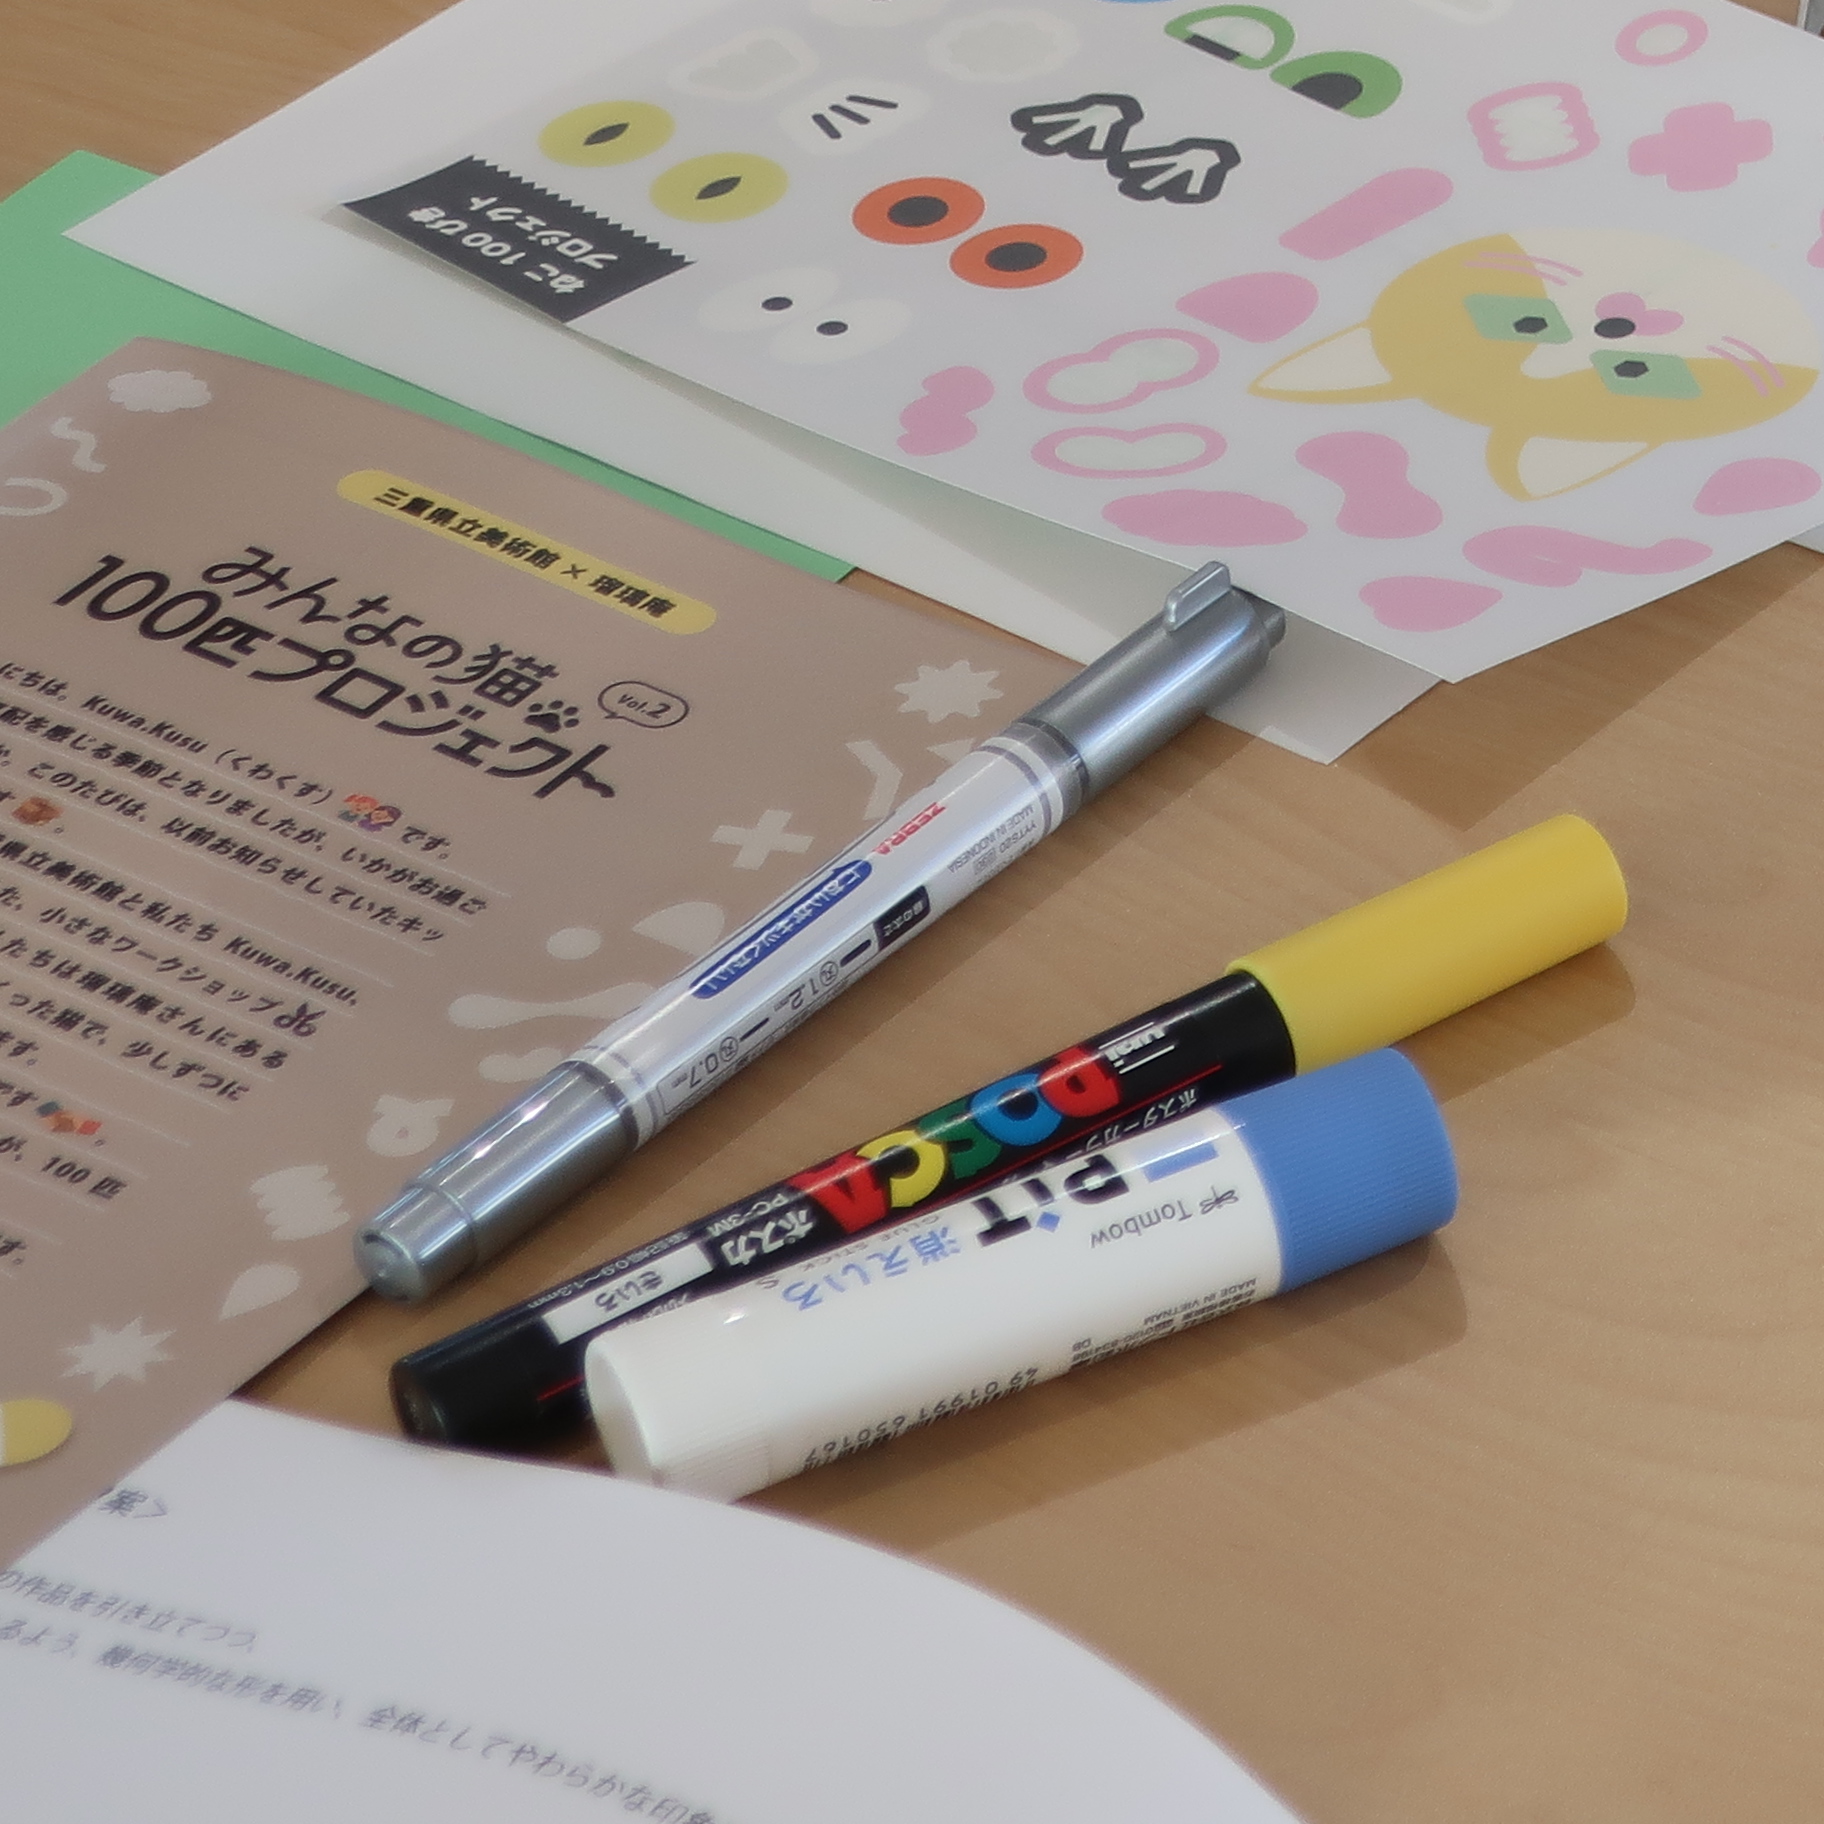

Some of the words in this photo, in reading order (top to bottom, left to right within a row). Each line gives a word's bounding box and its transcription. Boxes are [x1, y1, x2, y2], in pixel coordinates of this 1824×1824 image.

[469, 196, 618, 269] プロジェクト
[202, 546, 560, 709] みんなの猫
[53, 554, 616, 799] 100匹プロジェクト
[618, 693, 671, 719] Vol.2
[0, 701, 488, 916] 配を感じる季節となりましたが、いかがお過ご
[872, 802, 946, 855] ZEBRA
[787, 1044, 1121, 1235] POSCA
[706, 1192, 790, 1237] PC-3M
[720, 1207, 816, 1266] ポスカ
[1089, 1198, 1194, 1249] Tombow
[594, 1269, 663, 1313] きいろ
[781, 1223, 961, 1311] 消えいろ
